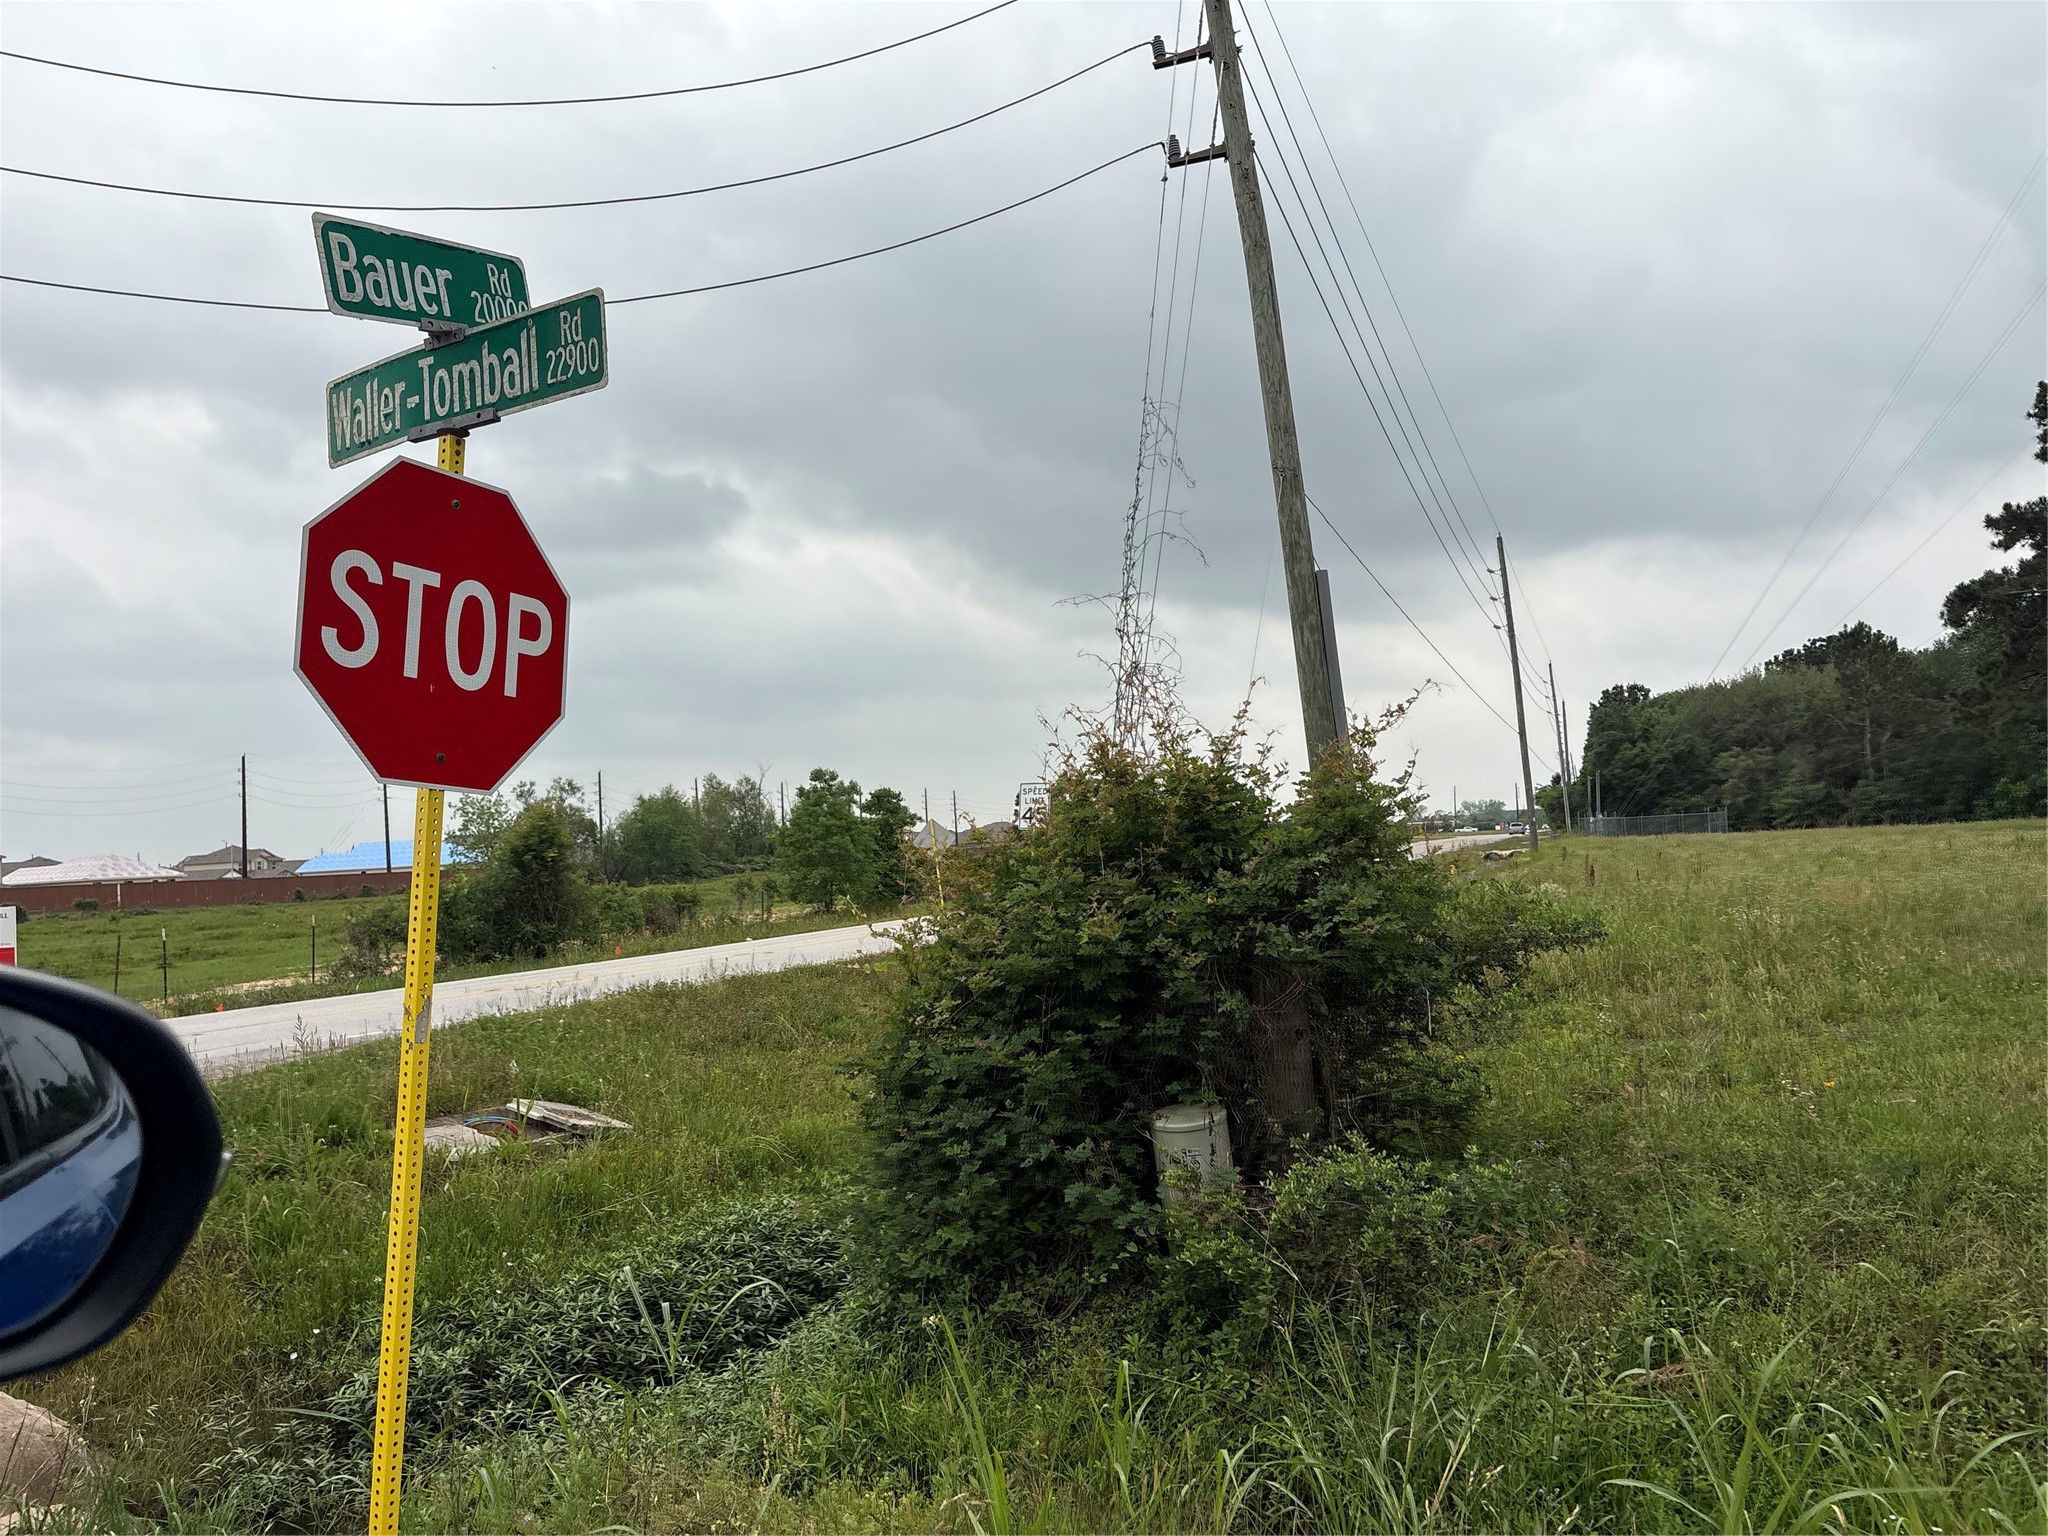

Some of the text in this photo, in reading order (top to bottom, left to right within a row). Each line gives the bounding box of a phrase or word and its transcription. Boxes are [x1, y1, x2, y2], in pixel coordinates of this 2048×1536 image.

[328, 231, 452, 317] Bauer
[487, 263, 512, 297] Rd
[559, 307, 582, 344] Rd
[546, 337, 599, 385] 22900
[331, 320, 539, 452] Waller-Tomball
[321, 549, 553, 698] STOP
[1022, 787, 1047, 795] SPEED
